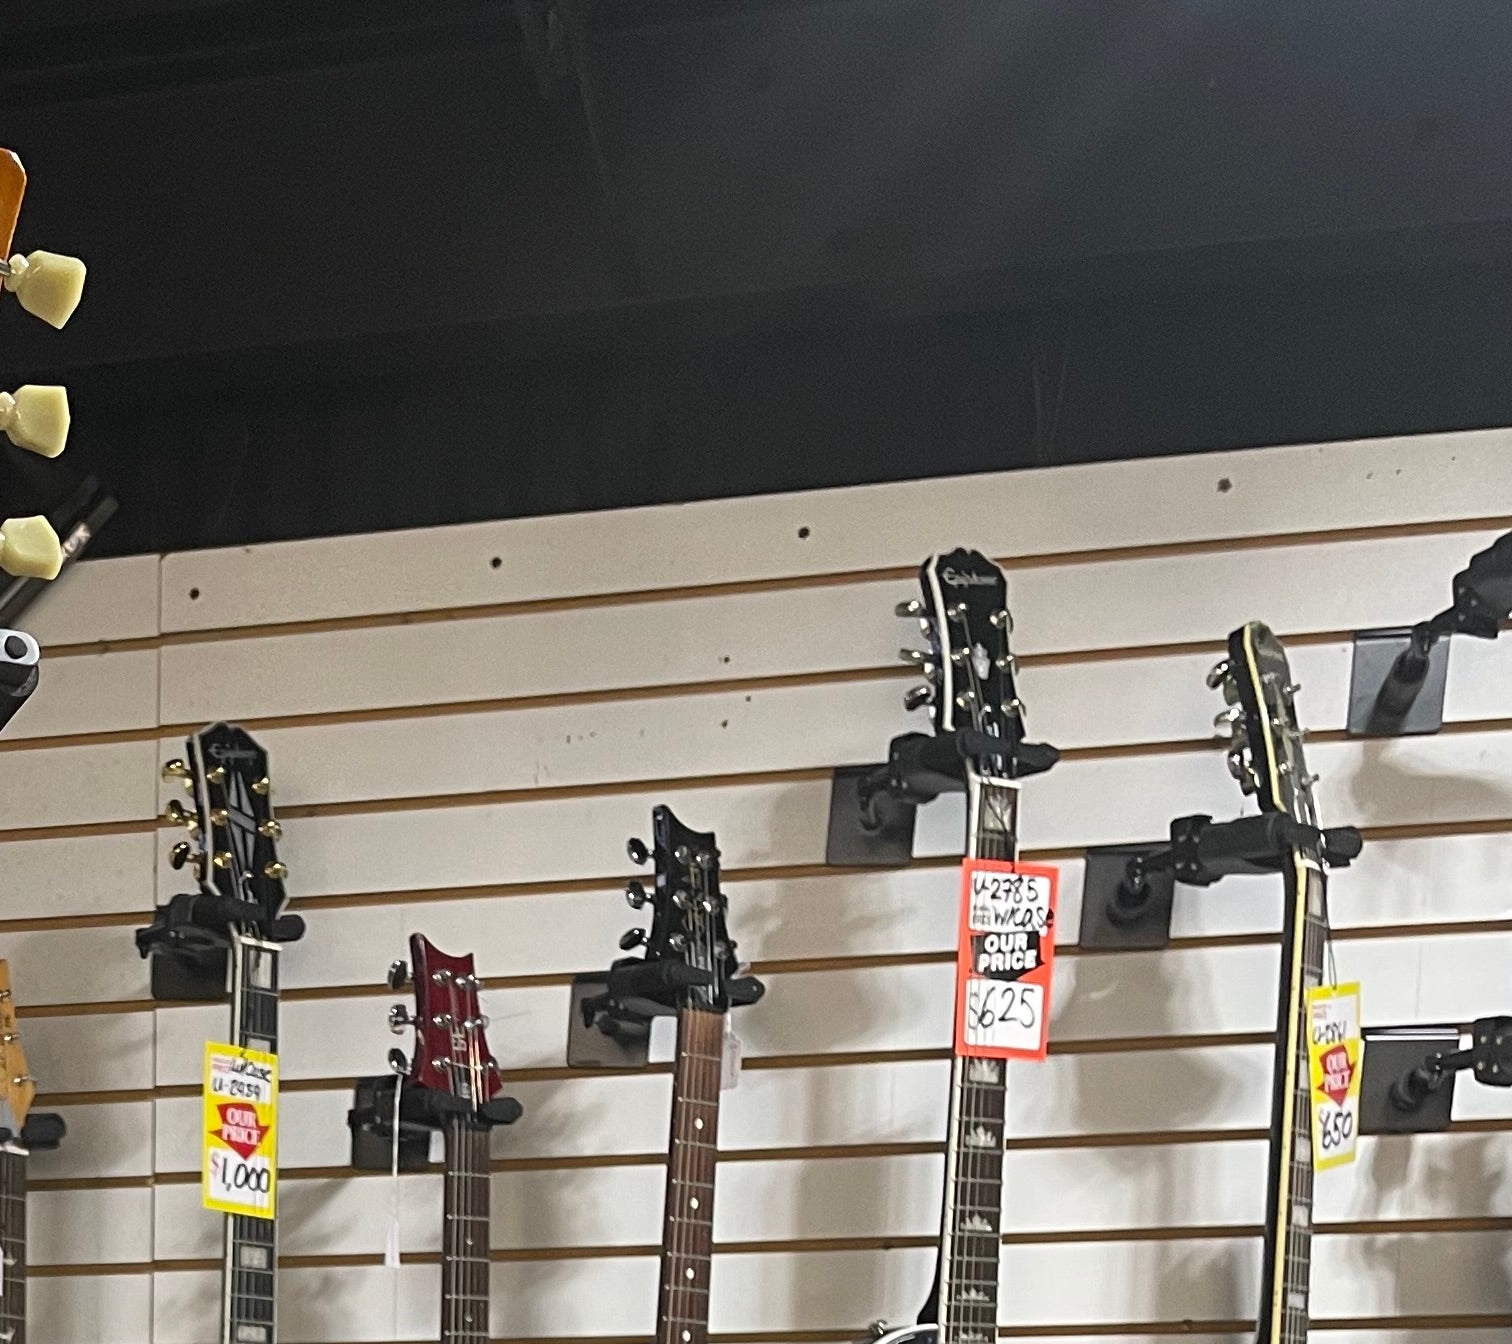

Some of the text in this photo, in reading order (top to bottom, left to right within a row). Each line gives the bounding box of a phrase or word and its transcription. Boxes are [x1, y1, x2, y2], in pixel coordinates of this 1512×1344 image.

[984, 932, 1029, 953] OUR
[977, 949, 1038, 974] PRICE
[968, 986, 1036, 1031] $625
[225, 1106, 258, 1128] OUR
[221, 1123, 261, 1146] PRICE
[210, 1151, 271, 1194] $1,000
